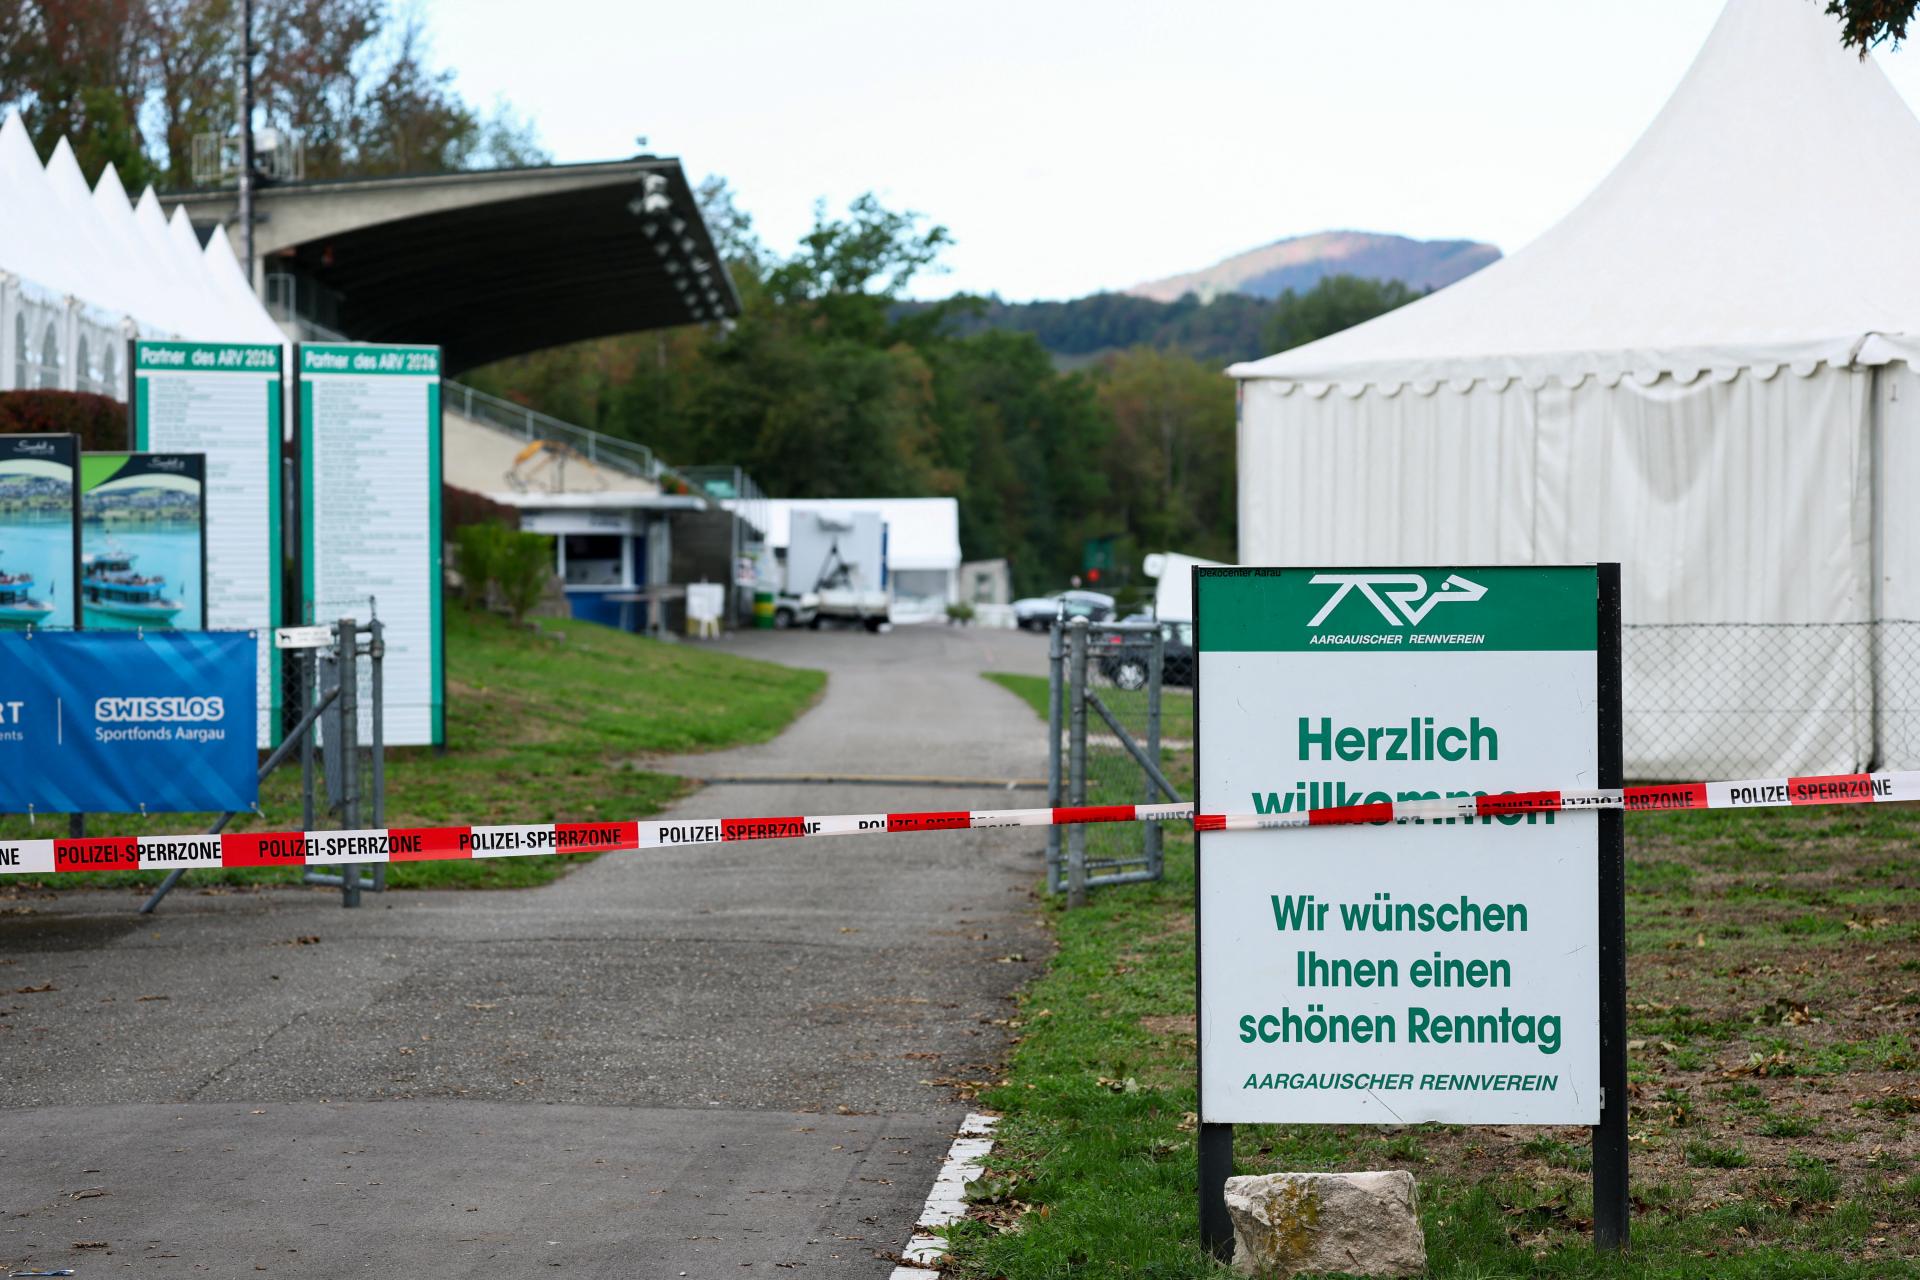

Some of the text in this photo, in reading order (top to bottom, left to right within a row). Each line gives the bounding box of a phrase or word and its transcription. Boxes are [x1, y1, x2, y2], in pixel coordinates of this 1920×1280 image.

[141, 347, 185, 365] Partner
[191, 349, 215, 366] des
[217, 350, 244, 366] ARV
[305, 351, 349, 368] Partner
[353, 353, 377, 369] des
[378, 353, 405, 370] ARV
[1310, 634, 1485, 645] AARGAUISCHER RENNVEREIN
[95, 696, 224, 721] SWISSLOS
[95, 726, 225, 743] Sportfonds Aargau
[1299, 717, 1498, 761] Herzlich
[1731, 778, 1893, 805] POLIZEI-SPERRZONE
[259, 834, 422, 858] POLIZEI-SPERRZONE
[459, 828, 622, 850] POLIZEI-SPERRZONE
[57, 841, 222, 865] POLIZEI-SPERRZONE
[1271, 893, 1528, 931] Wir wünschen
[1297, 951, 1511, 987] Ihnen einen
[1239, 1004, 1561, 1054] schönen Renntag
[1242, 1073, 1558, 1091] AARGAUISCHER RENNVEREIN
